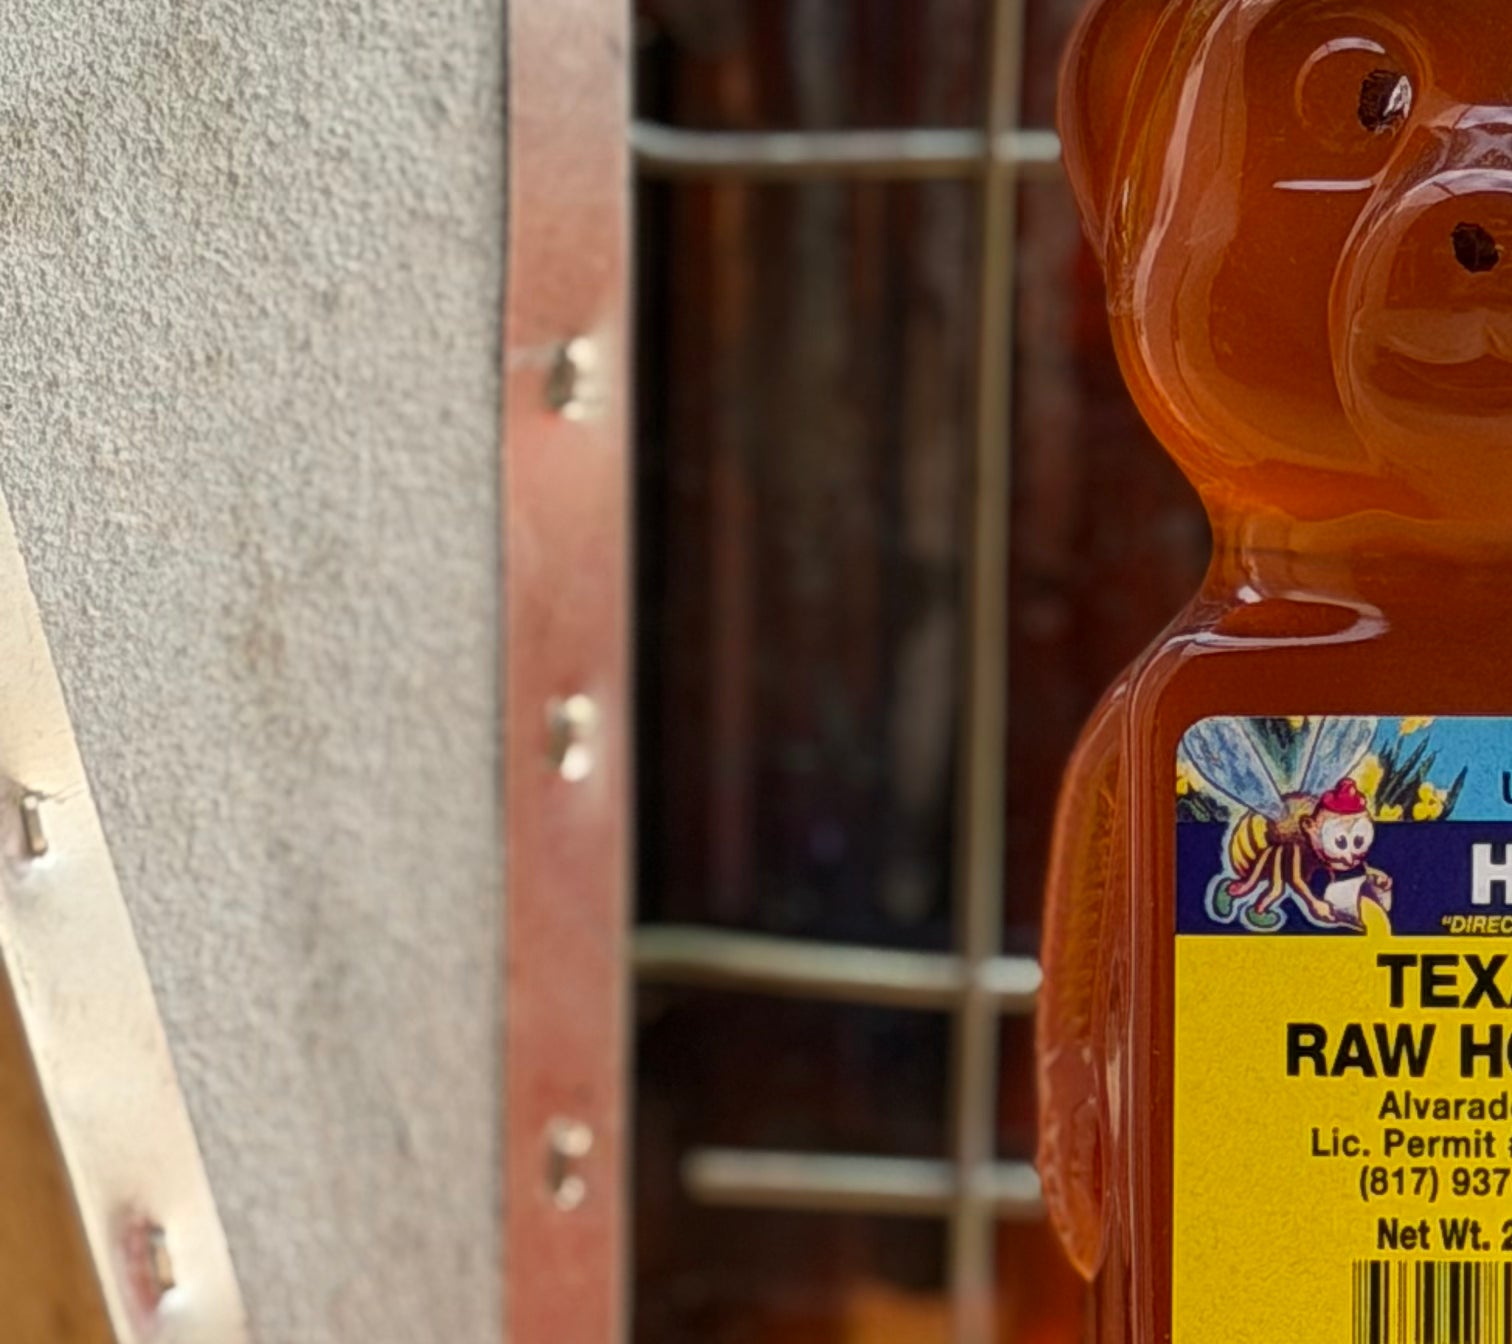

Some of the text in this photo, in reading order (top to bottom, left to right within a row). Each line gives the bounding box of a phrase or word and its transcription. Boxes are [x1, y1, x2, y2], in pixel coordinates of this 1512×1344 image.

[1285, 1023, 1436, 1078] RAW
[1311, 1128, 1371, 1158] Lic.
[1383, 1128, 1496, 1158] Permit
[1359, 1166, 1440, 1202] (817)
[1377, 1218, 1430, 1250] Net
[1439, 1218, 1491, 1250] Wt.
